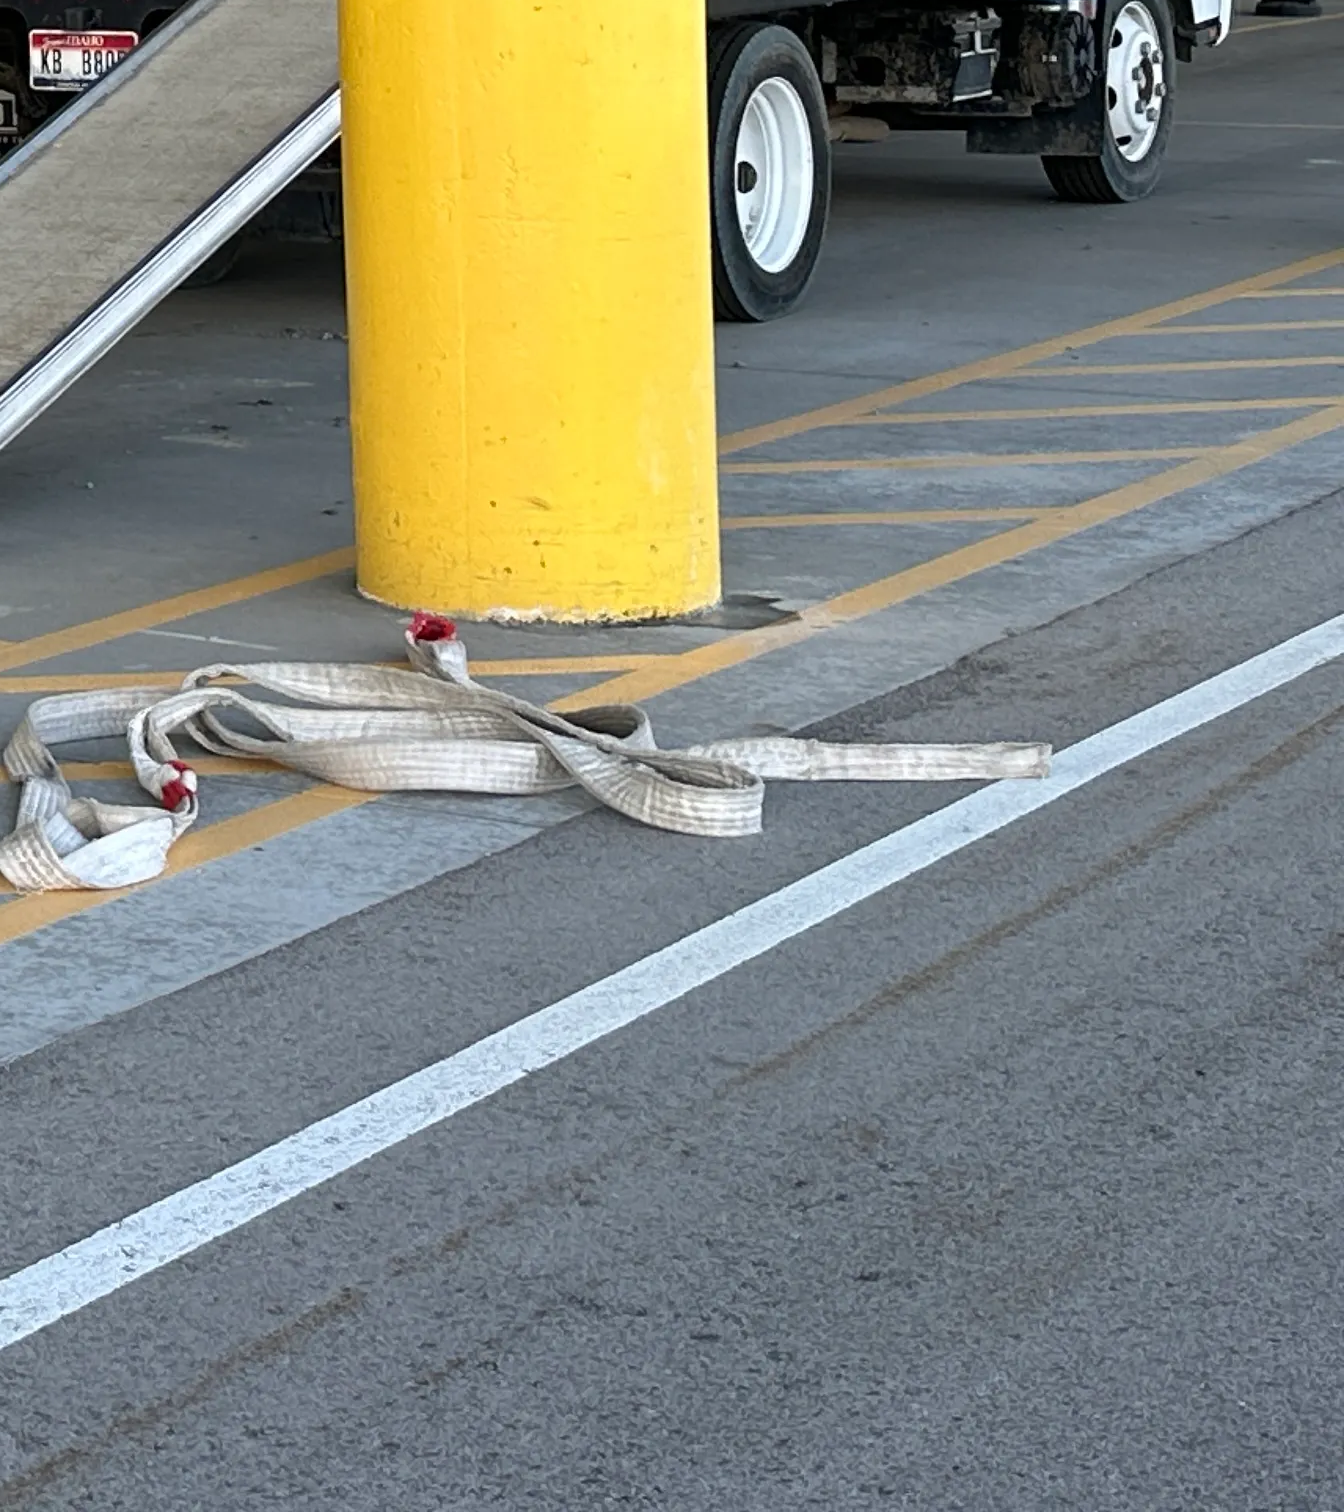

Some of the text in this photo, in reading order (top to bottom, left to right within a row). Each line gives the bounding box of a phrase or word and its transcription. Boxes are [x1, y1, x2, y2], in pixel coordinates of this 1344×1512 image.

[66, 35, 104, 46] IDAHO
[40, 48, 126, 75] KB B80
